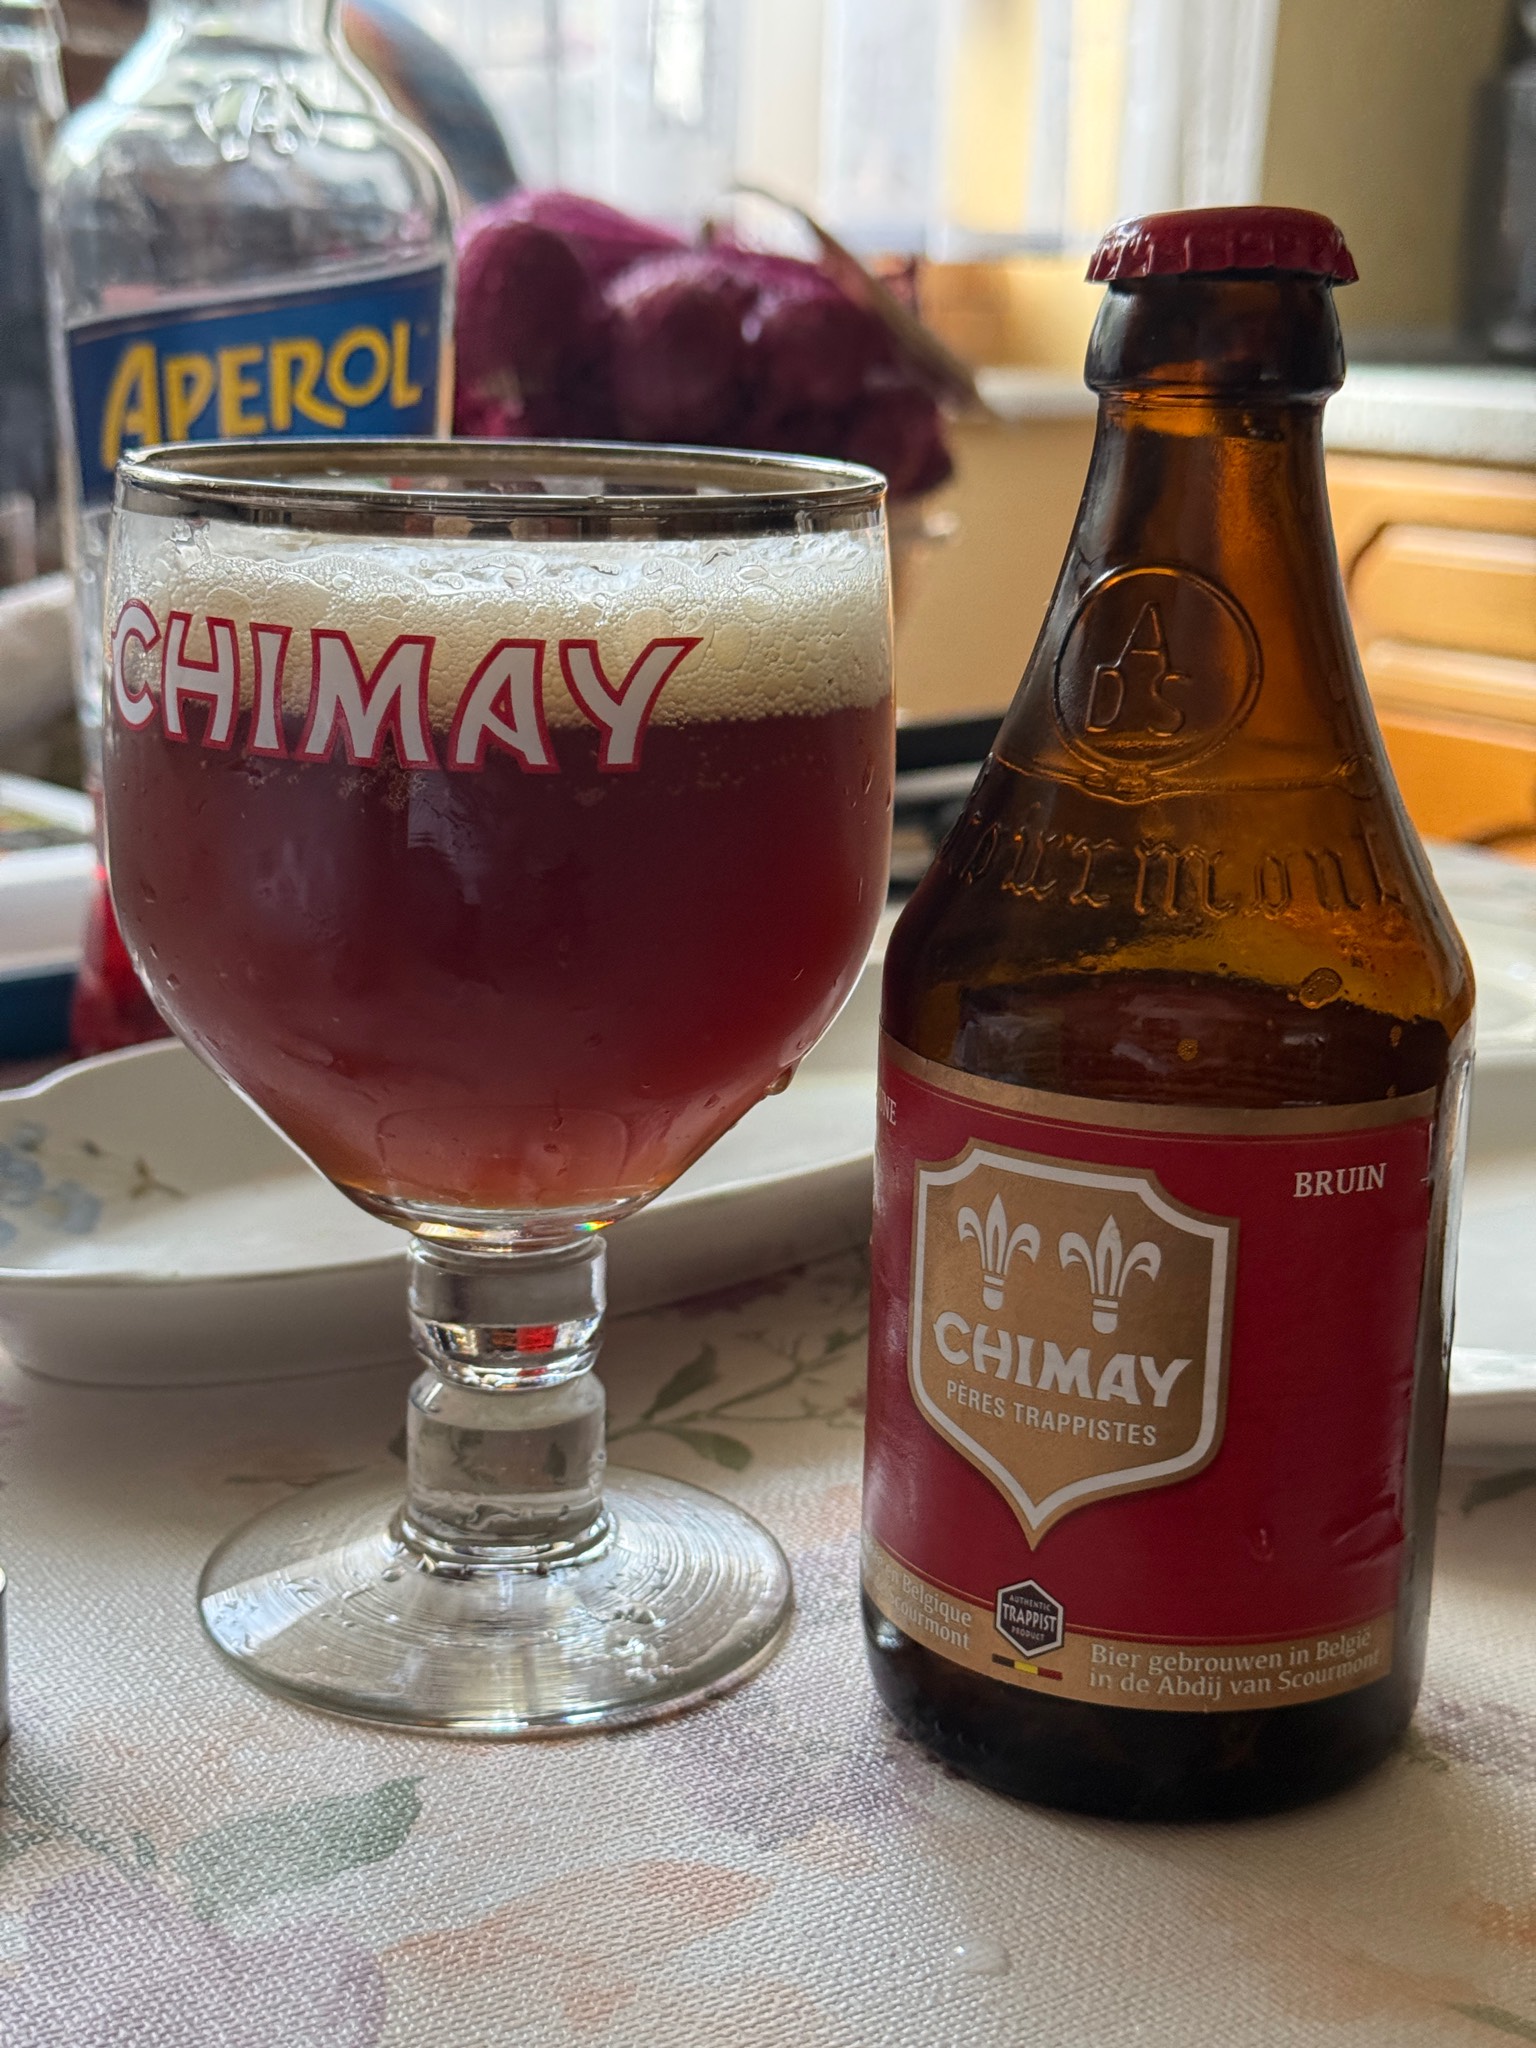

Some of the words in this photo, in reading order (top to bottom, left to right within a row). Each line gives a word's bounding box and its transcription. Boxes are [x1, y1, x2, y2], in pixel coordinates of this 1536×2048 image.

[102, 318, 423, 470] APEROL
[112, 600, 704, 774] CHIMAY
[1293, 1162, 1388, 1198] BRUIN
[933, 1311, 1193, 1408] CHIMAY
[946, 1376, 1006, 1419] PÈRES
[1013, 1400, 1157, 1447] TRAPPISTES
[902, 1573, 973, 1628] Belgique
[1002, 1602, 1057, 1633] TRAPPIST
[1009, 1594, 1052, 1612] AUTHENTIC
[1011, 1625, 1046, 1642] PRODUCT
[1090, 1643, 1142, 1668] Bier
[1148, 1651, 1282, 1676] gebrouwen
[1289, 1646, 1310, 1666] in
[1315, 1627, 1372, 1662] België
[1089, 1667, 1112, 1688] in
[1119, 1671, 1150, 1693] de
[1156, 1674, 1222, 1701] Abdij
[1230, 1677, 1271, 1695] van
[1277, 1649, 1381, 1691] Scourmont
